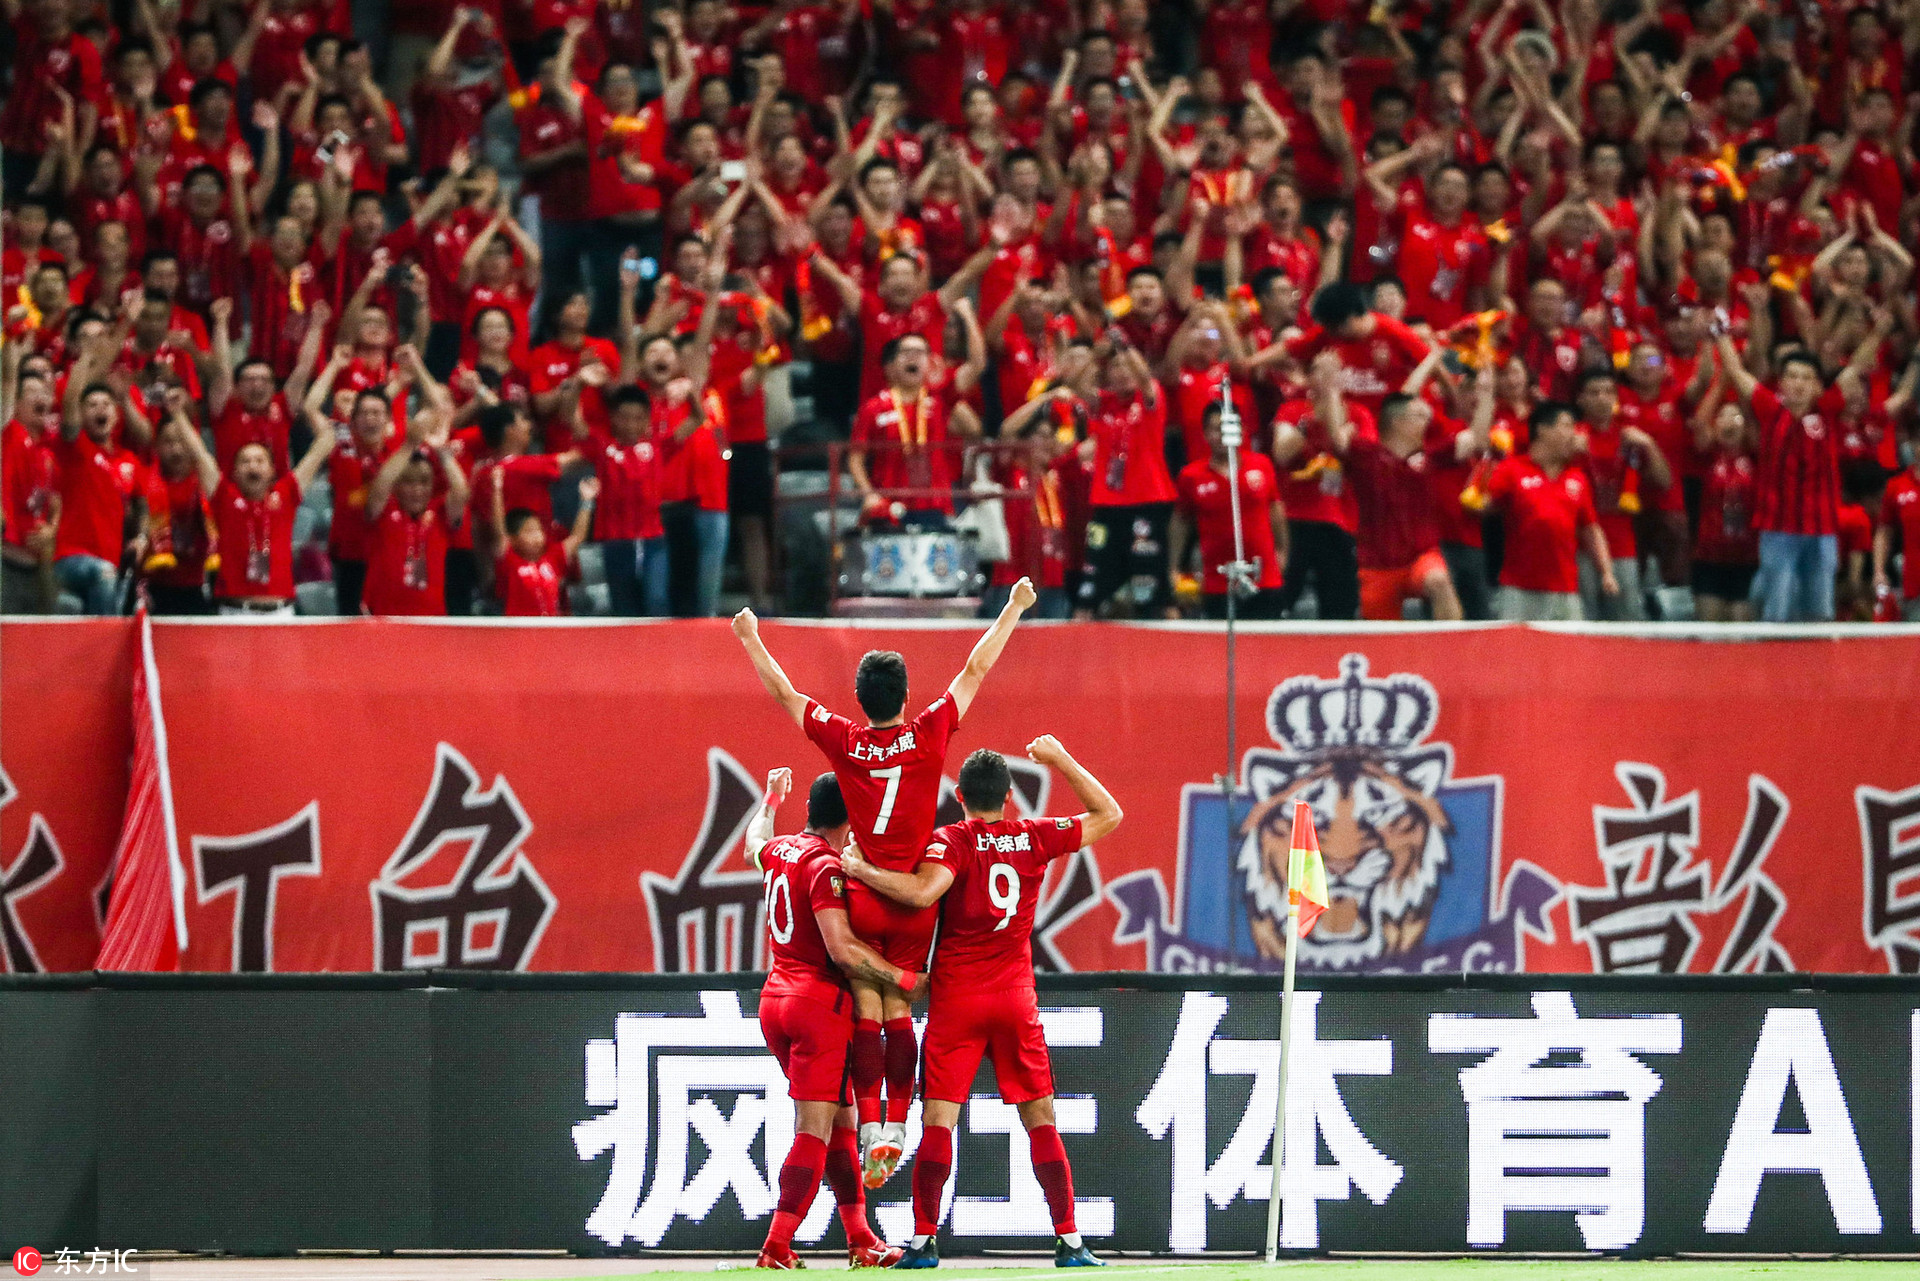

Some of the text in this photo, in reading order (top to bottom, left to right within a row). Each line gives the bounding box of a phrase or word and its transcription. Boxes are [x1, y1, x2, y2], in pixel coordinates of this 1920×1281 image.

[869, 764, 902, 835] 7
[763, 868, 795, 945] 10
[988, 862, 1021, 931] 9
